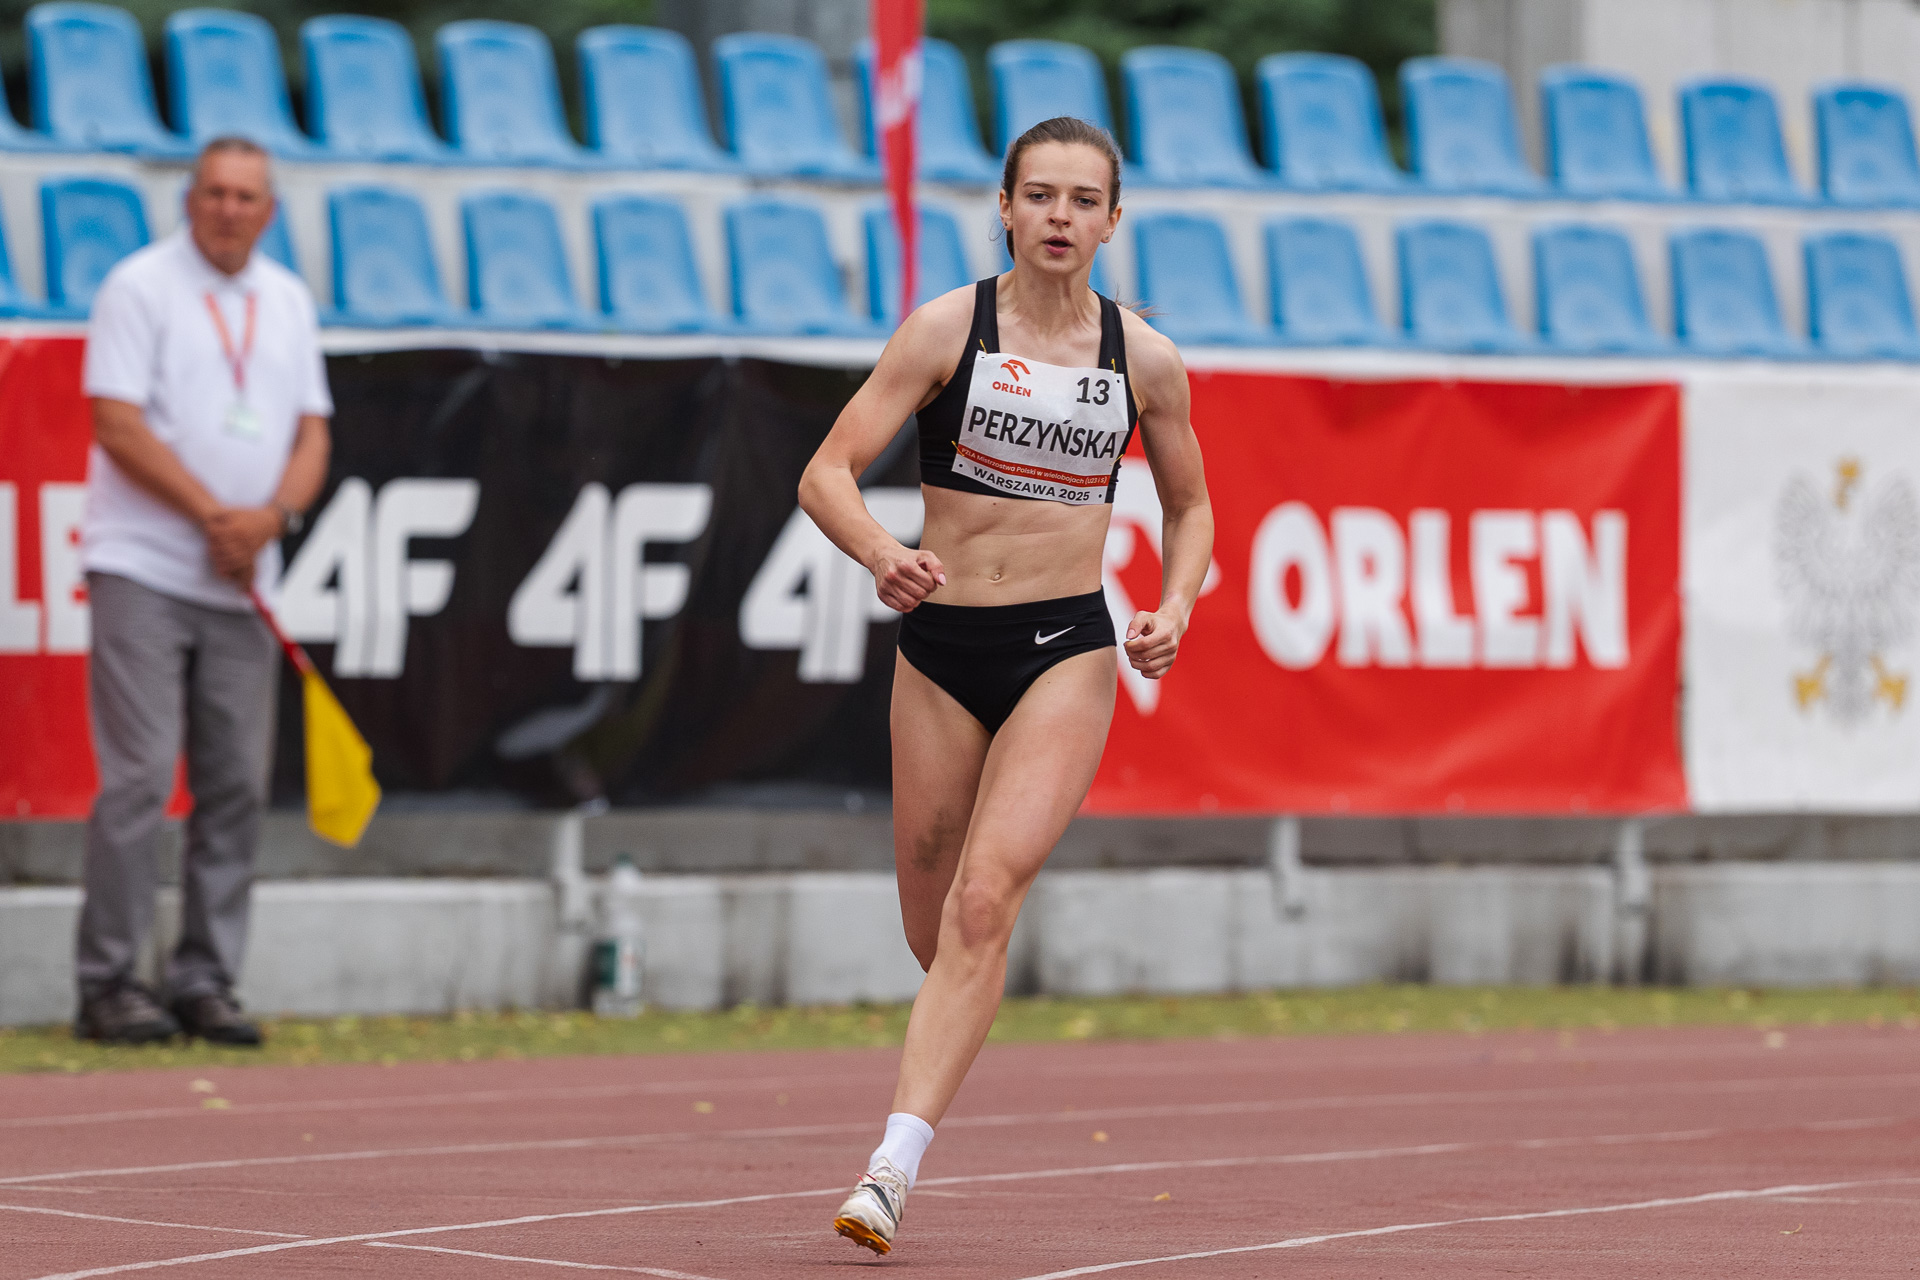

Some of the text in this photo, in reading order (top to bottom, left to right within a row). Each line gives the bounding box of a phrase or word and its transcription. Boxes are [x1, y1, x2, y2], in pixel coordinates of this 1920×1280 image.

[992, 381, 1032, 398] ORLEN
[1076, 376, 1110, 406] 13
[968, 405, 1116, 459] PERZYŃSKA
[974, 466, 1090, 501] WARSZAWA 2025
[976, 454, 1015, 472] Mistrzostwa
[1016, 466, 1035, 475] Polski
[1043, 471, 1084, 484] wielobojach
[278, 478, 480, 679] 4F
[507, 482, 713, 682] 4F
[1249, 501, 1630, 671] ORLEN
